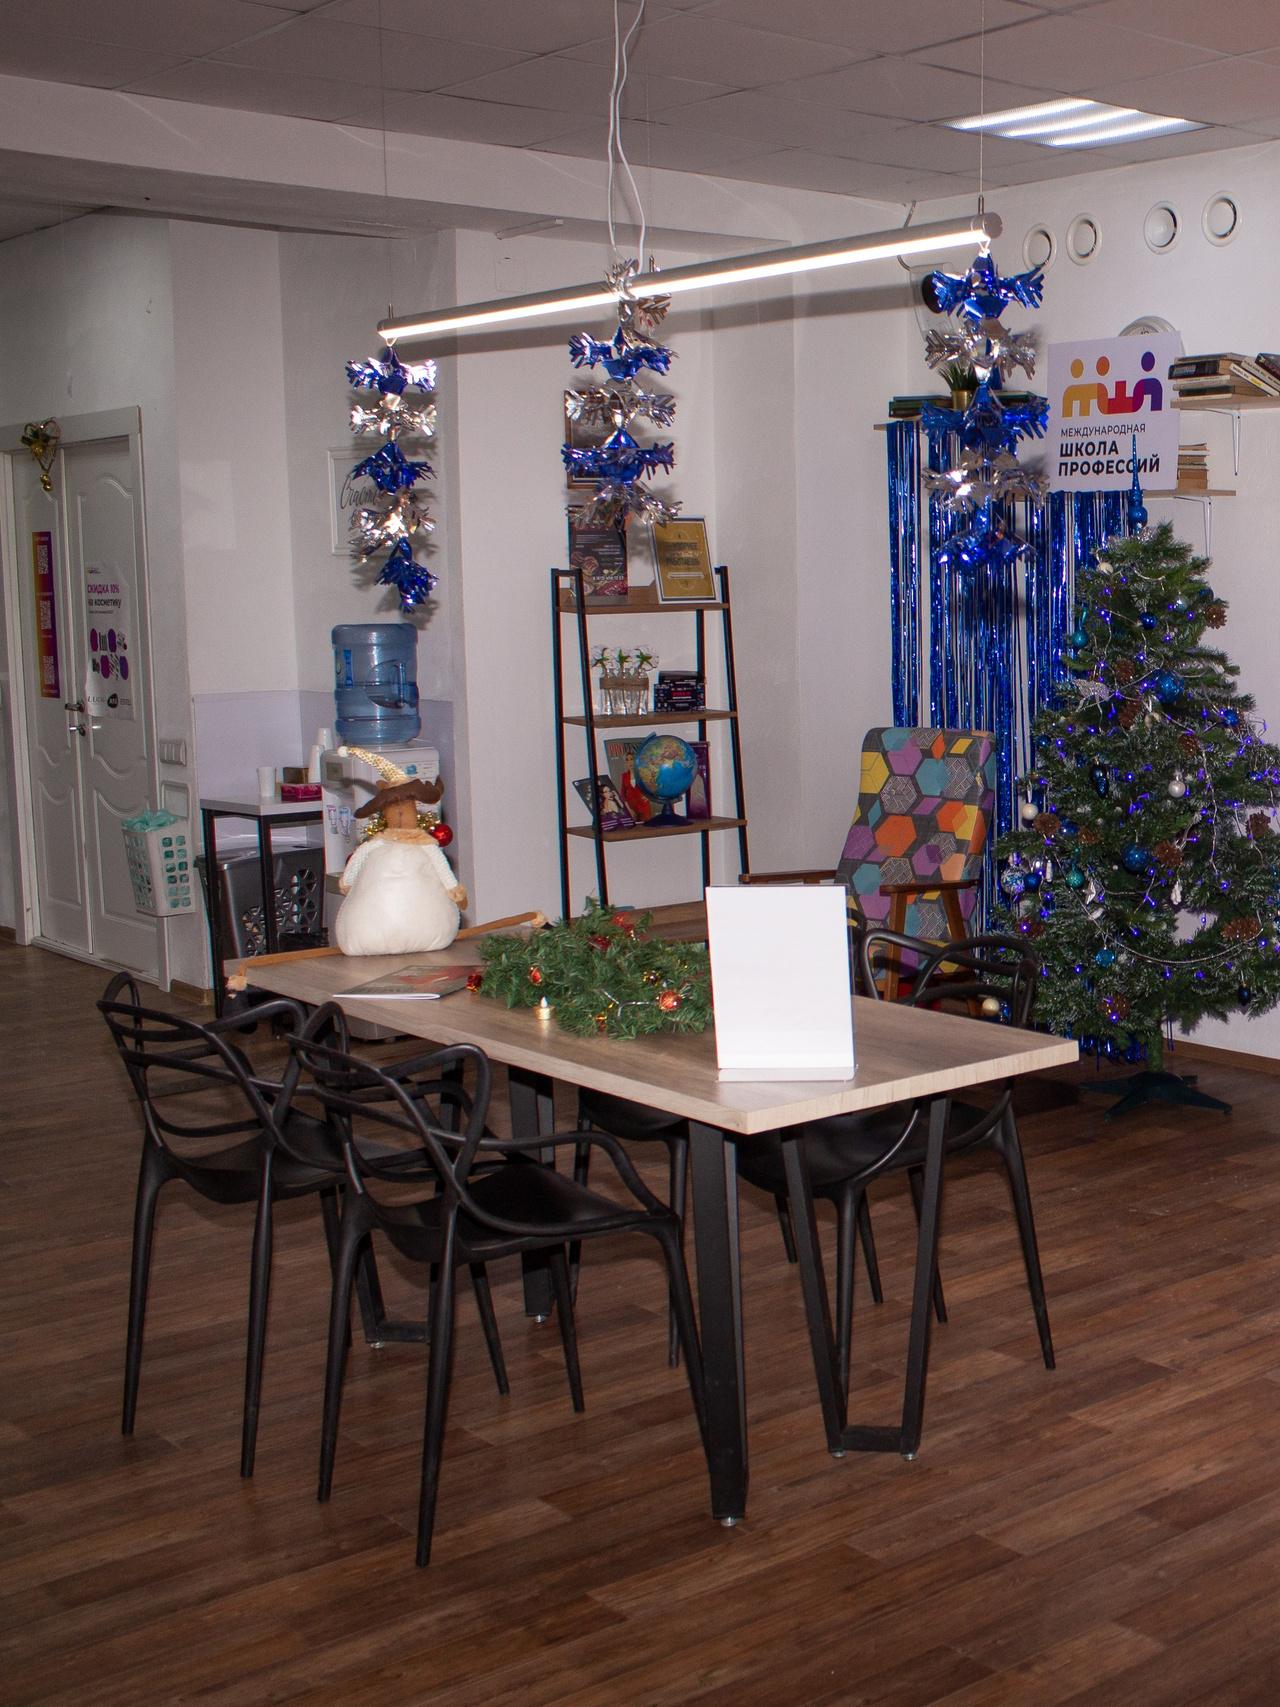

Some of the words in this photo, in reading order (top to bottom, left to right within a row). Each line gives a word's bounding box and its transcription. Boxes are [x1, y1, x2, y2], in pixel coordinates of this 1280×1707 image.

[1060, 423, 1146, 438] МЕЖДУНАРОДНАЯ
[1060, 440, 1120, 458] ШКОЛА
[1058, 454, 1160, 477] ПРОФЕССИЙ
